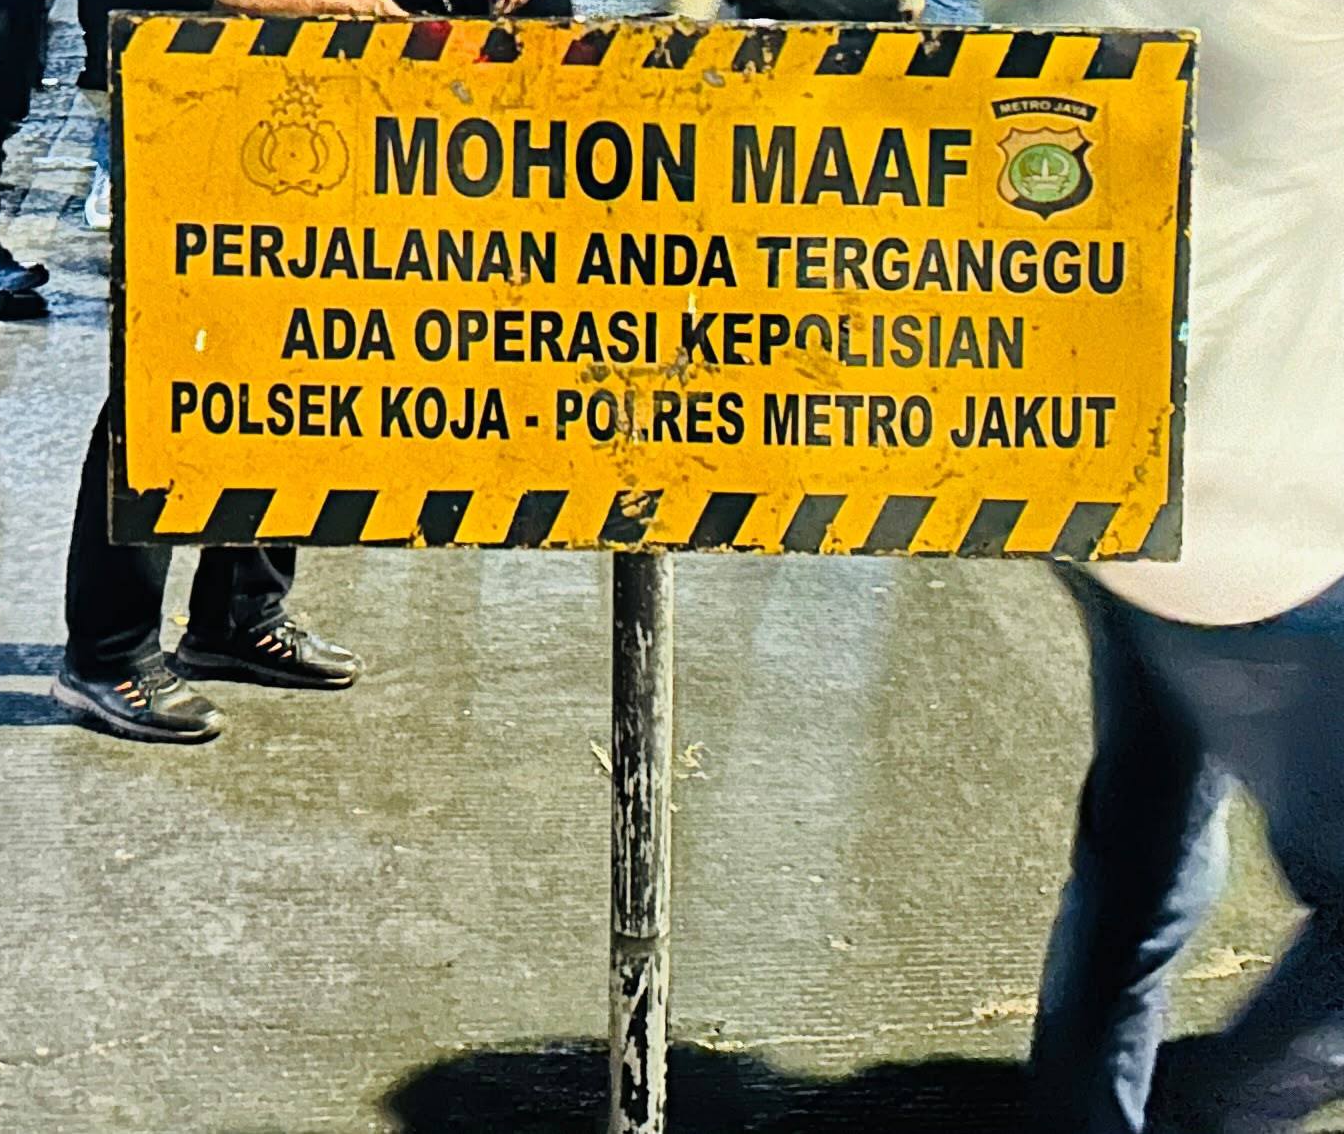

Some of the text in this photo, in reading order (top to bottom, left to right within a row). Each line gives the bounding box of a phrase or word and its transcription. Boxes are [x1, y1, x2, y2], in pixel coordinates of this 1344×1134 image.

[999, 99, 1088, 118] METRO JAYA
[374, 116, 972, 208] MOHON MAAF
[175, 223, 1125, 295] PERJALANAN ANDA TERGANGGU
[281, 307, 1024, 369] ADA OPERASI KEPOLISIAN
[171, 381, 363, 437] POLSEK
[380, 386, 510, 440] KOJA
[556, 388, 745, 445] POLRES
[763, 393, 933, 448] METRO
[950, 396, 1117, 449] JAKUT
